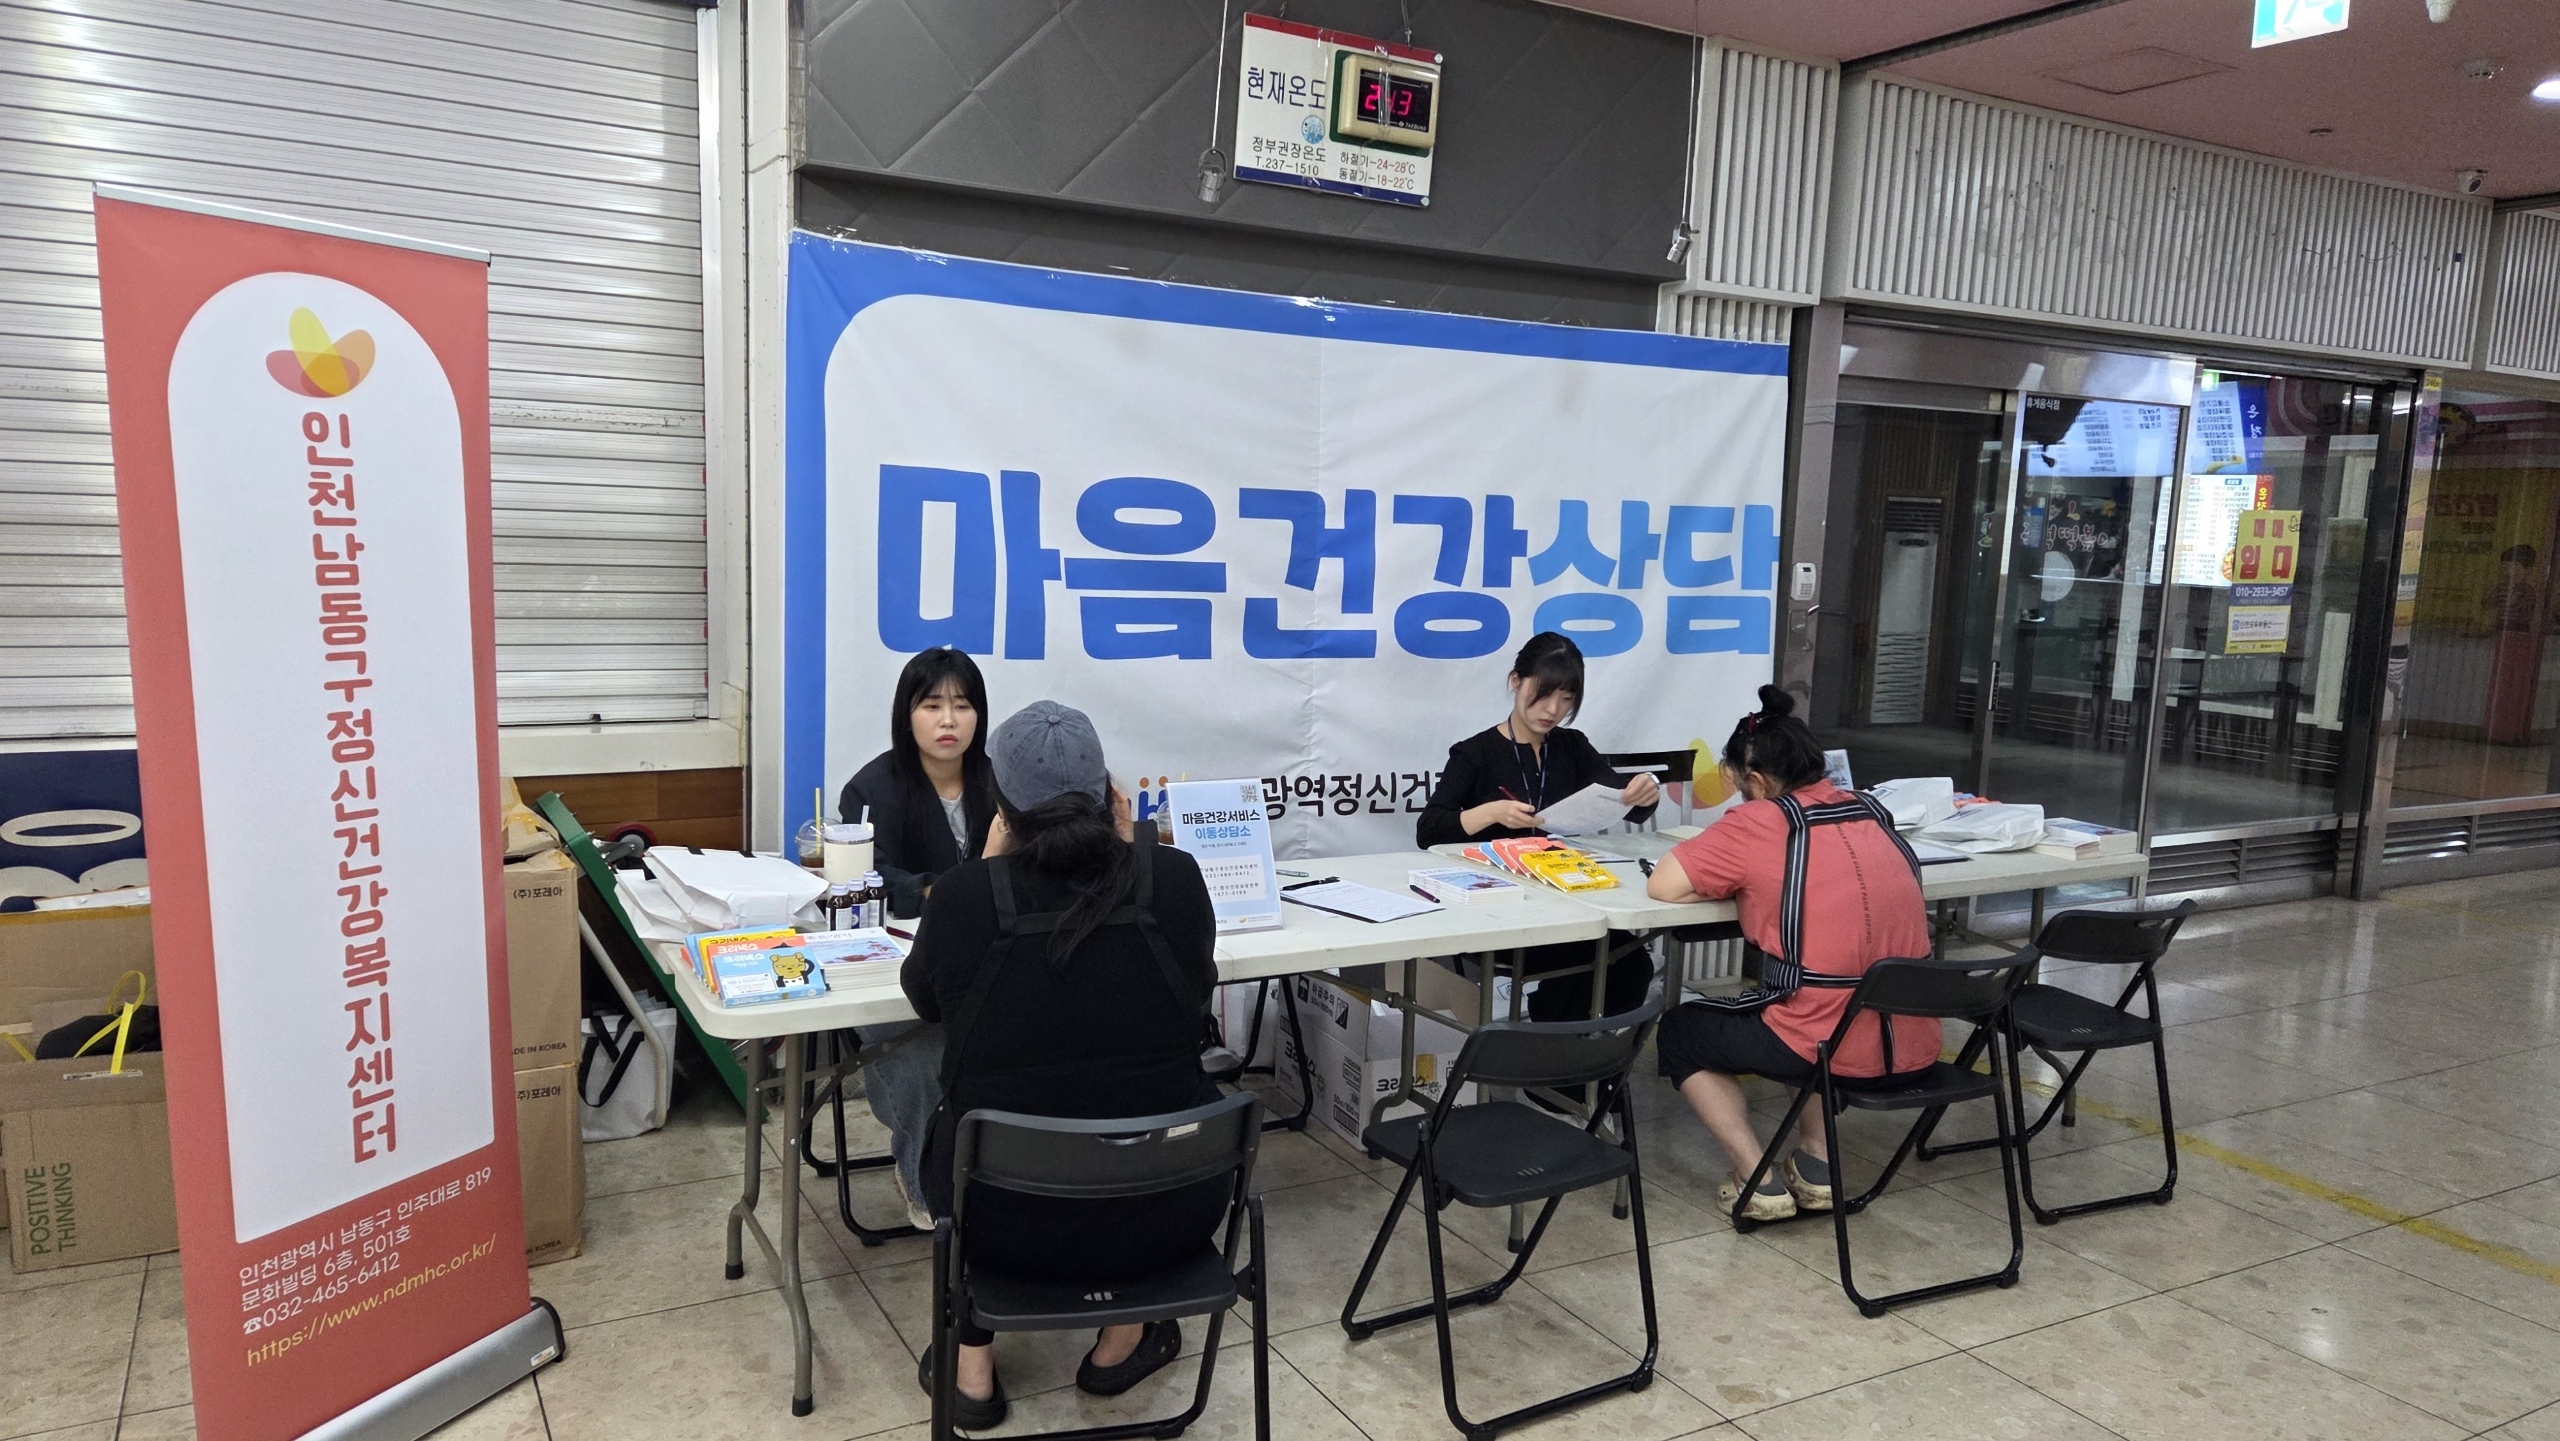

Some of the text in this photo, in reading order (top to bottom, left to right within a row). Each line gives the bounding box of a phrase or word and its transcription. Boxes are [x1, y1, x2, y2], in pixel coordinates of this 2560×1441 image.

[1247, 66, 1327, 110] 현재온도
[1252, 136, 1327, 163] 정부권장온도
[1254, 156, 1319, 176] T.237-1510
[2026, 396, 2060, 411] 휴게음식점
[2235, 587, 2289, 597] 010-2933-3457
[301, 411, 398, 1163] 인천남동구정신건강복지센터
[1262, 771, 1446, 820] 광역정신건
[1182, 809, 1261, 825] 마음건강서비스
[1195, 825, 1252, 840] 이동상담소
[513, 886, 563, 899] (주)포레아
[1312, 982, 1335, 1006] 취급주의
[527, 1045, 537, 1053] IN
[539, 1041, 567, 1052] KOREA
[517, 1085, 562, 1101] 주)포레아
[24, 1165, 52, 1256] POSITIVE
[52, 1162, 77, 1253] THINKING
[239, 1166, 492, 1288] 인천광역시 남동구 인주대로 819
[241, 1224, 412, 1312] 문화빌딩 6층, 501호
[247, 1233, 498, 1368] https://www.ndmhc.or.kr/
[263, 1253, 400, 1328] 032-465-6412
